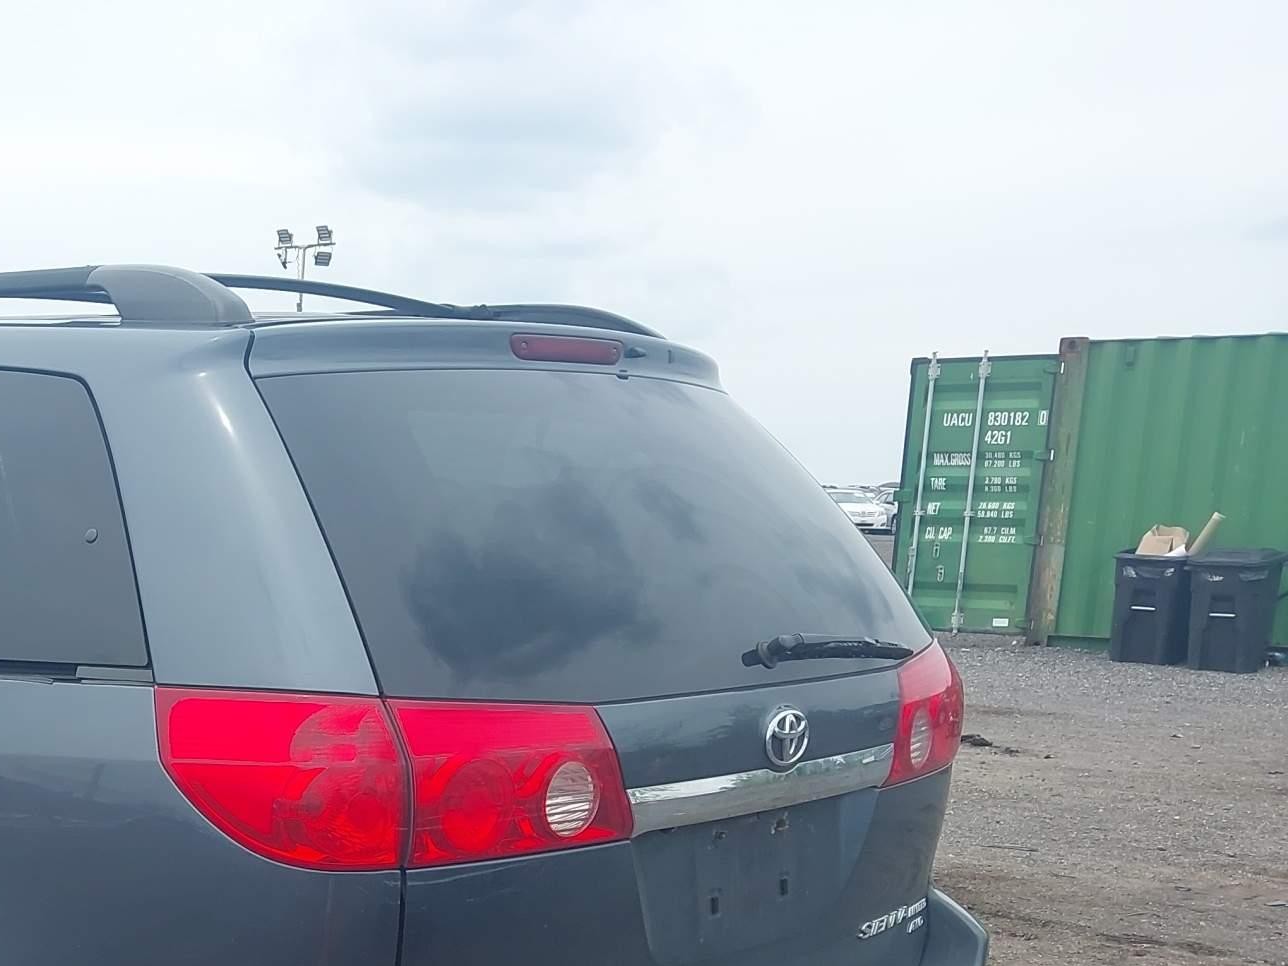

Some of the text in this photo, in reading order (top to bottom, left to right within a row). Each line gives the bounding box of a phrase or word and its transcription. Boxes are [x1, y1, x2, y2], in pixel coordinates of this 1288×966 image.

[943, 410, 1048, 426] UACU 830182 0
[984, 430, 1011, 445] 42G1
[933, 453, 972, 466] MAX.GROSS
[930, 477, 947, 490] TARE
[1005, 476, 1017, 485] KGS
[927, 502, 941, 515] NET
[1002, 502, 1016, 510] KGS
